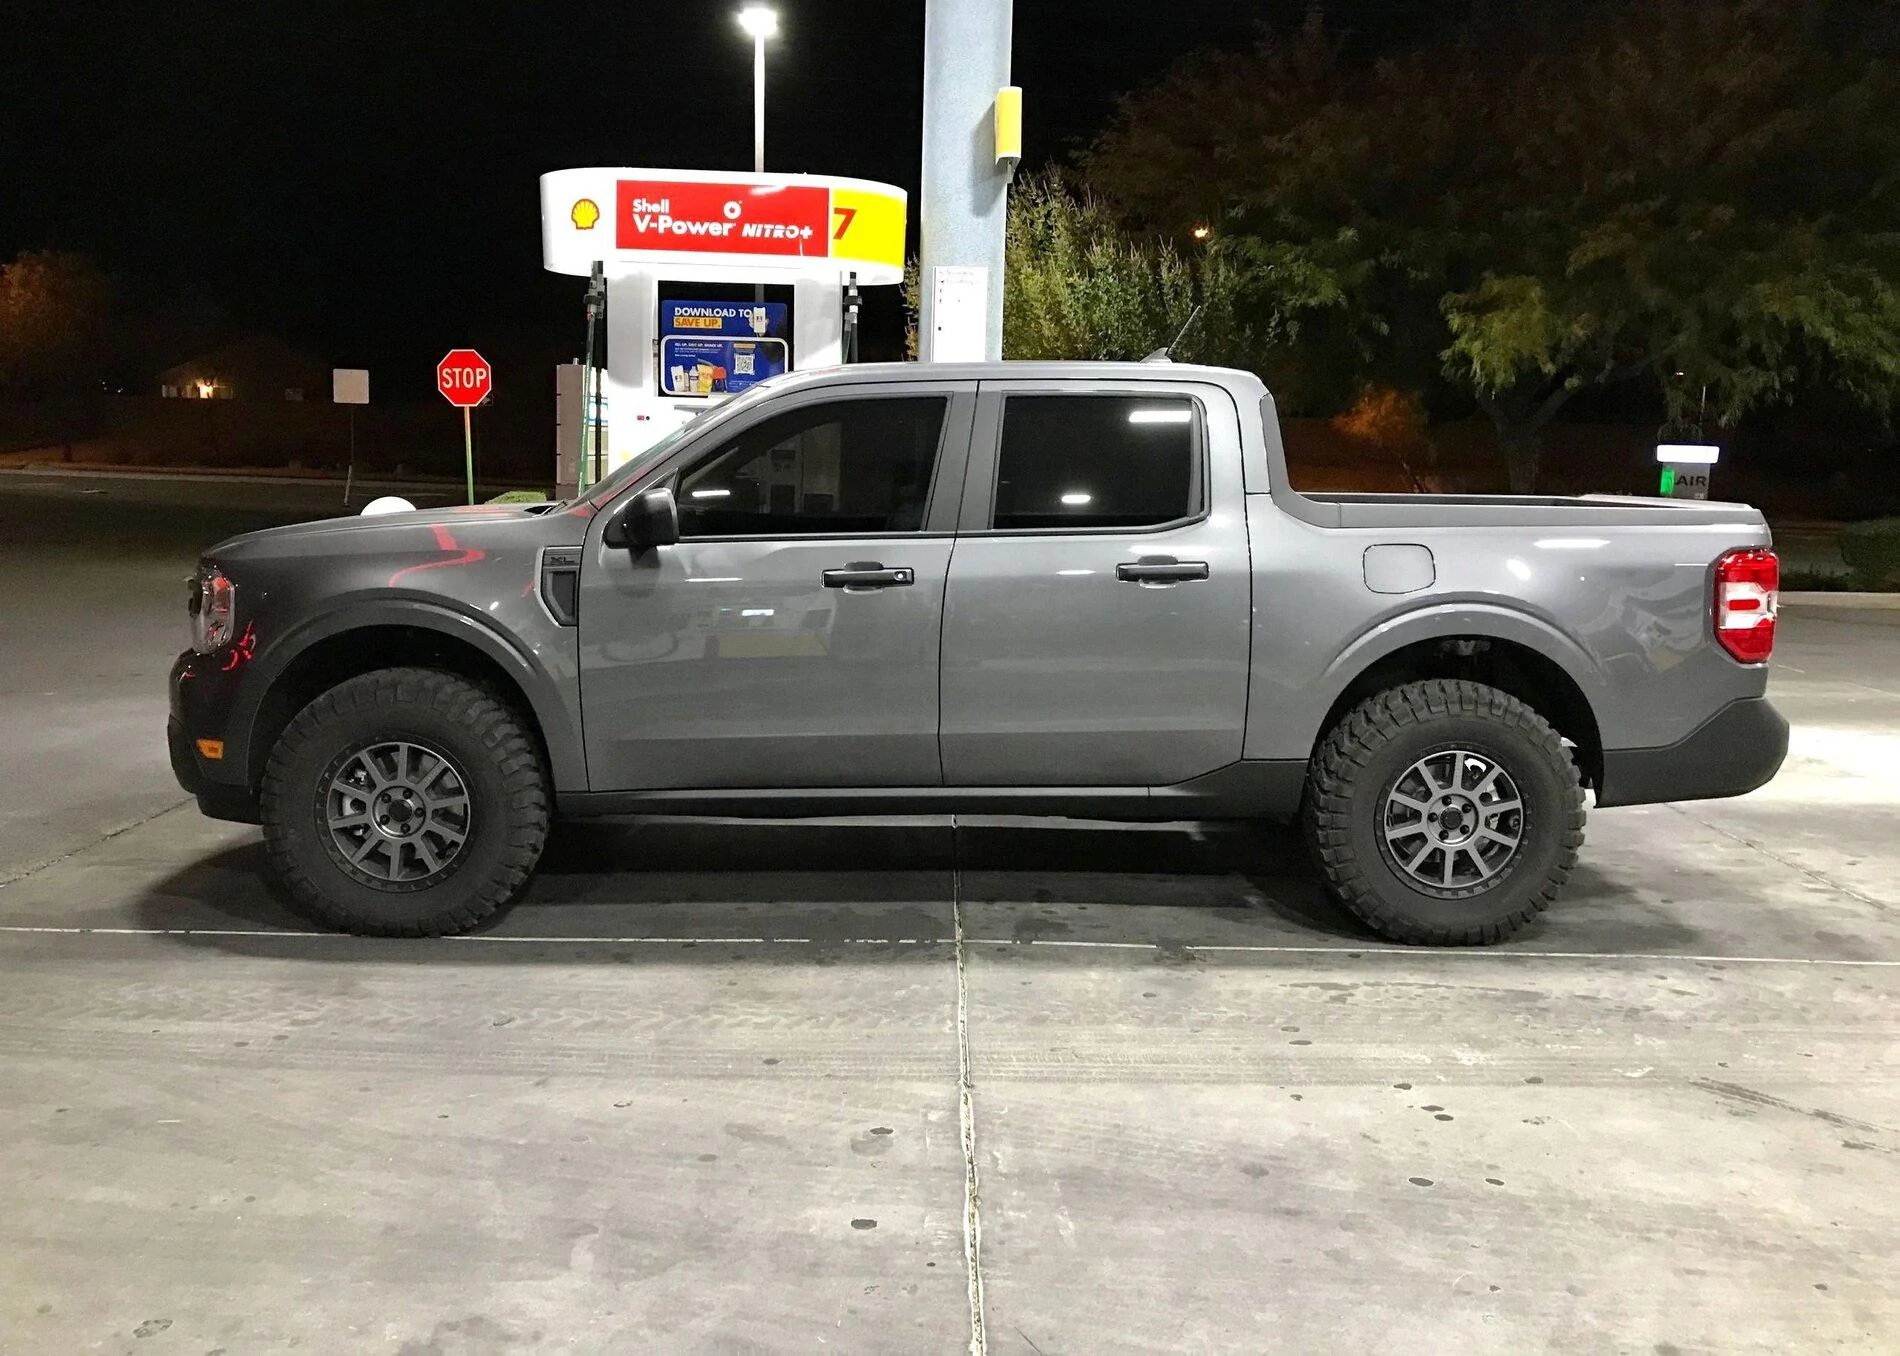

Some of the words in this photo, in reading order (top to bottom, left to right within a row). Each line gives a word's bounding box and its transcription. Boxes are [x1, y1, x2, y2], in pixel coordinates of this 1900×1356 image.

[632, 198, 670, 213] Shell
[632, 213, 733, 237] V-Power
[833, 207, 857, 240] 7
[674, 306, 737, 318] DOWNLOAD
[738, 308, 752, 318] TO
[675, 317, 700, 327] SAVE
[442, 367, 487, 389] STOP
[1675, 475, 1707, 487] AIR
